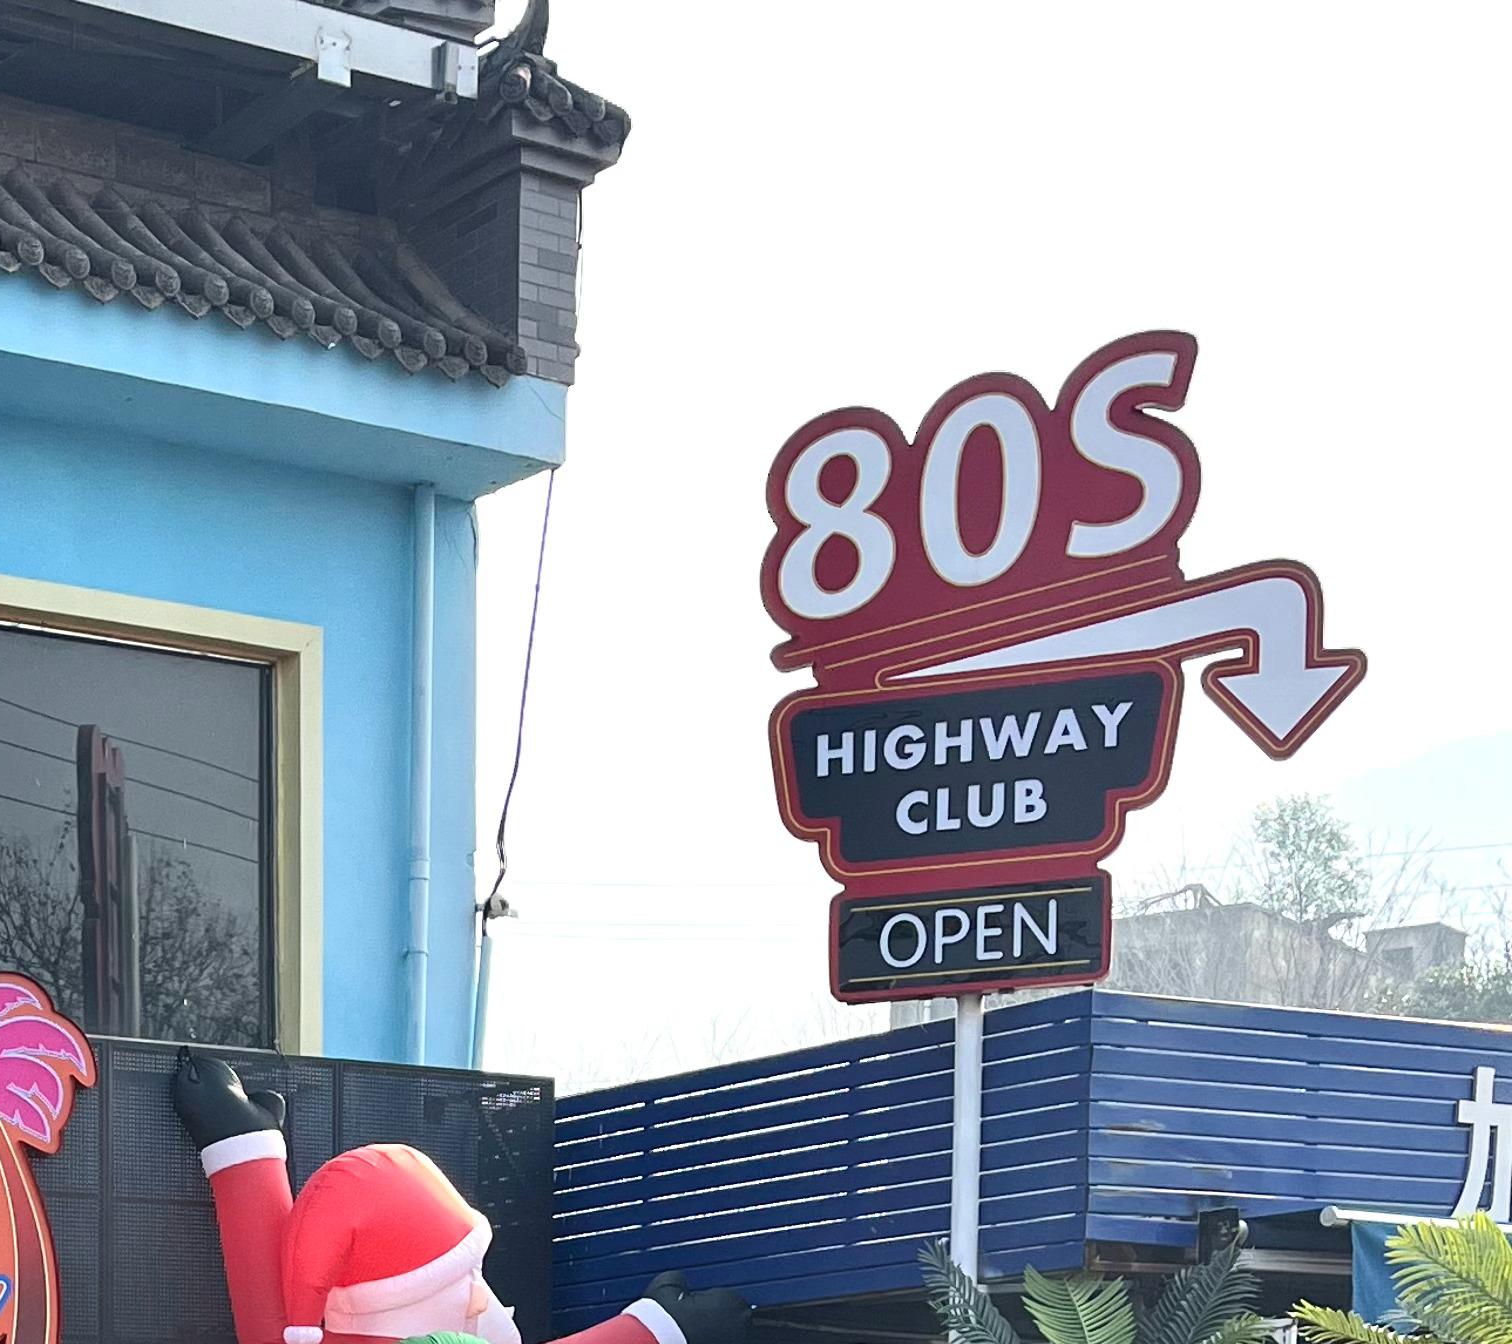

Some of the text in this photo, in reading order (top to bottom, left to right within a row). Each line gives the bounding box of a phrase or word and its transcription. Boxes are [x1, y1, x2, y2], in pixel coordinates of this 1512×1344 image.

[778, 350, 1184, 621] 80S
[816, 700, 1134, 778] HIGHWAY
[895, 777, 1048, 836] CLUB
[879, 897, 1059, 969] OPEN
